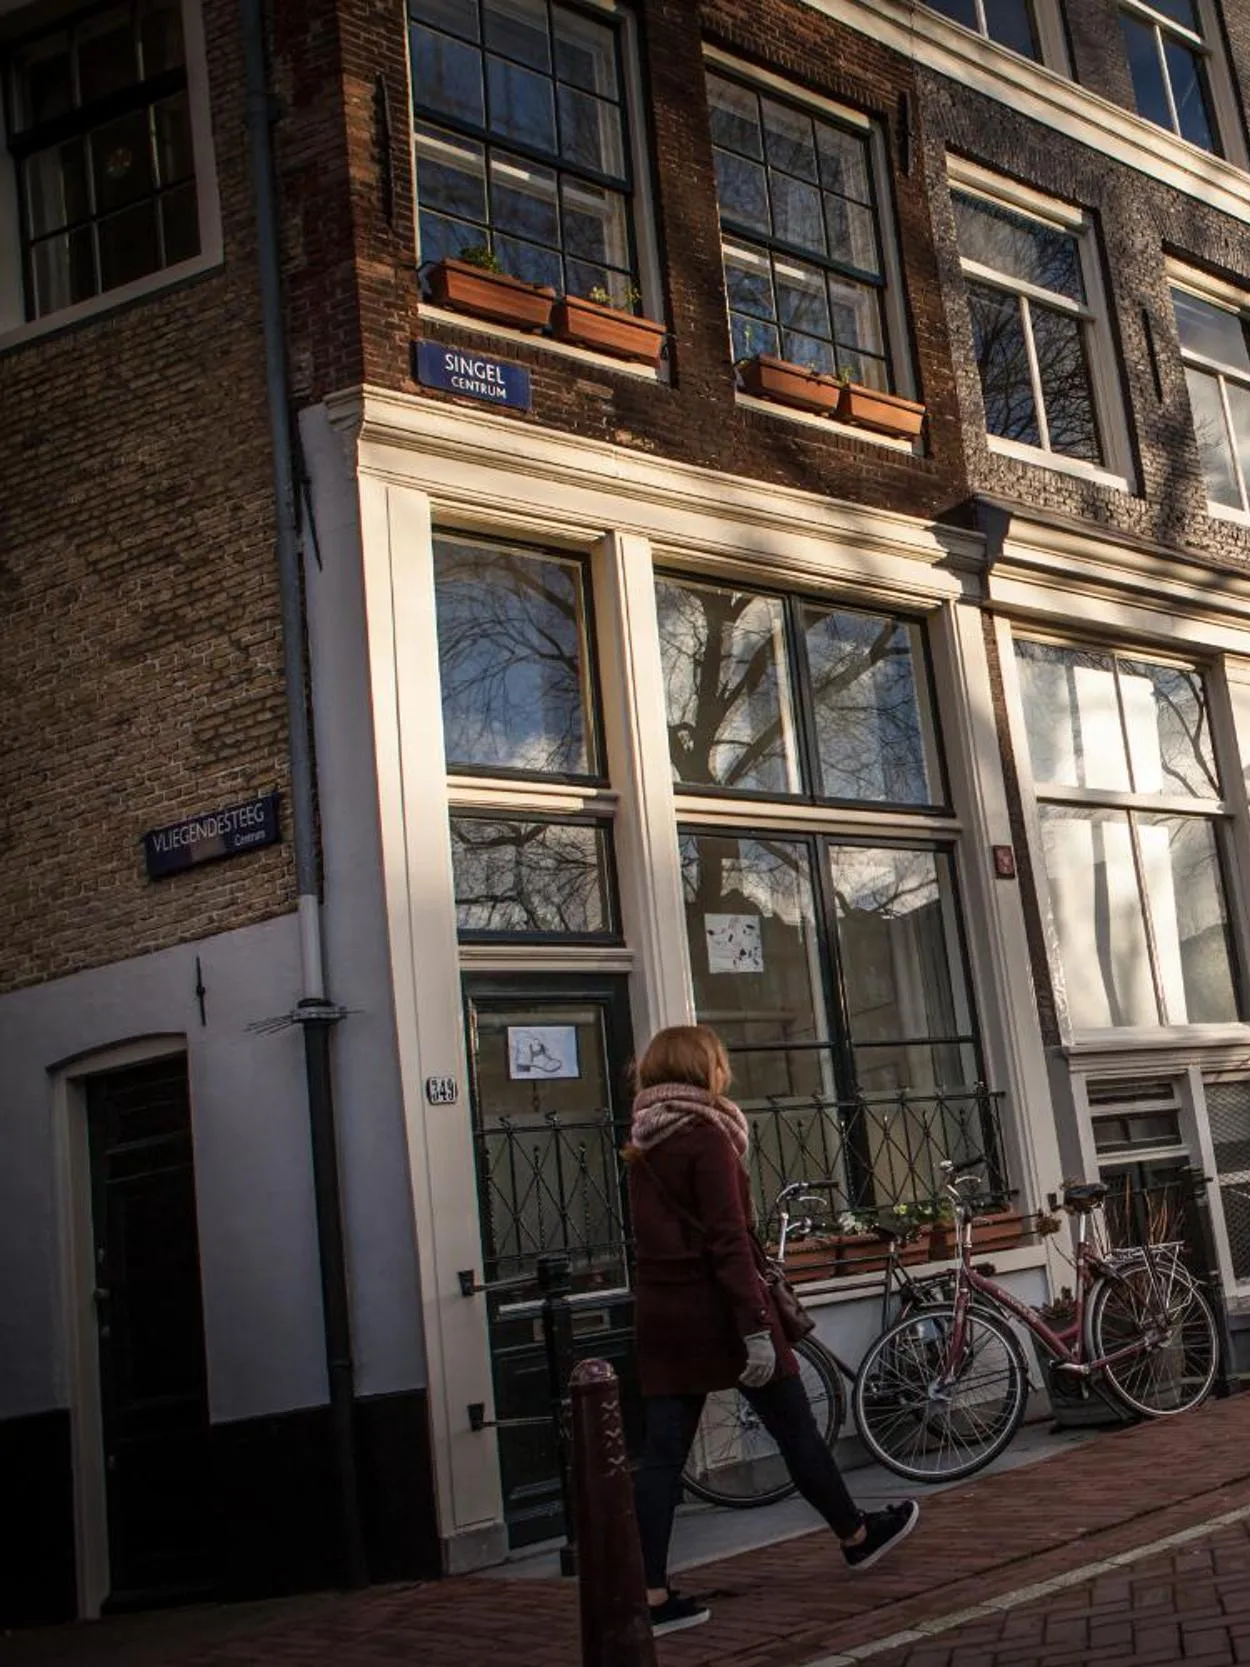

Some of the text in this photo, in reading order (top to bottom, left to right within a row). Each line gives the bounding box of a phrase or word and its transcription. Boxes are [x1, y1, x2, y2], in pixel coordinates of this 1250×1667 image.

[445, 353, 505, 384] SINGEL
[451, 376, 507, 399] CENTRUM
[152, 803, 264, 853] VLIEGENDESTEEG
[431, 1078, 455, 1102] 349
